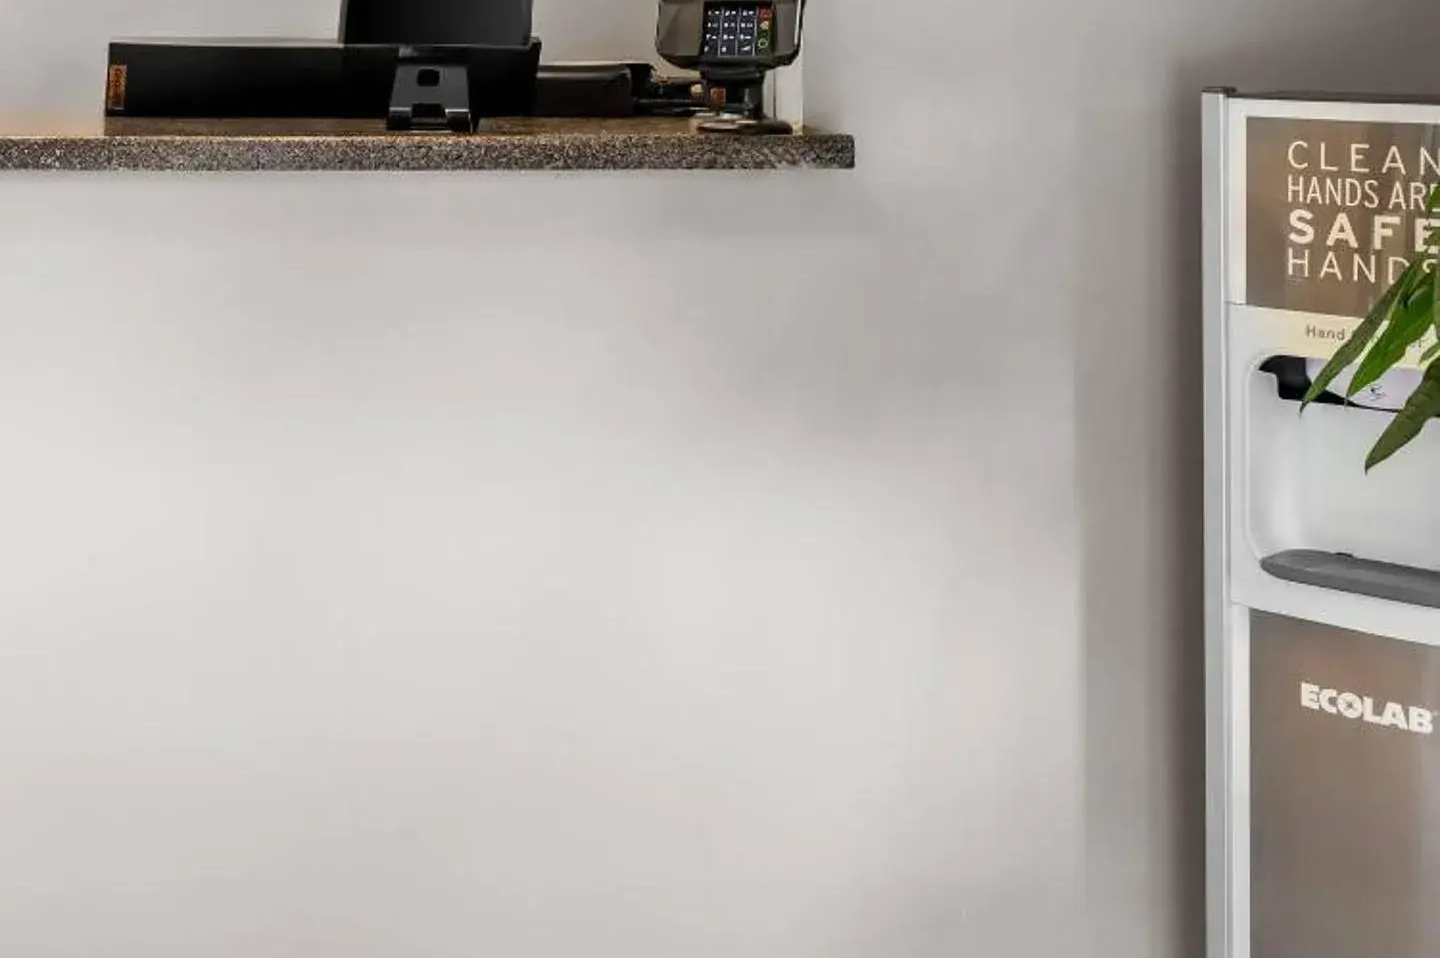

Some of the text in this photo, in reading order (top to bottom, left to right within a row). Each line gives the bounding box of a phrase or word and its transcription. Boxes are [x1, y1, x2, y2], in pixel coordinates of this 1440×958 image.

[1287, 141, 1440, 176] CLEAN
[1287, 174, 1379, 209] HANDS
[1306, 324, 1346, 341] Hand
[1301, 681, 1433, 733] ECOLAB
